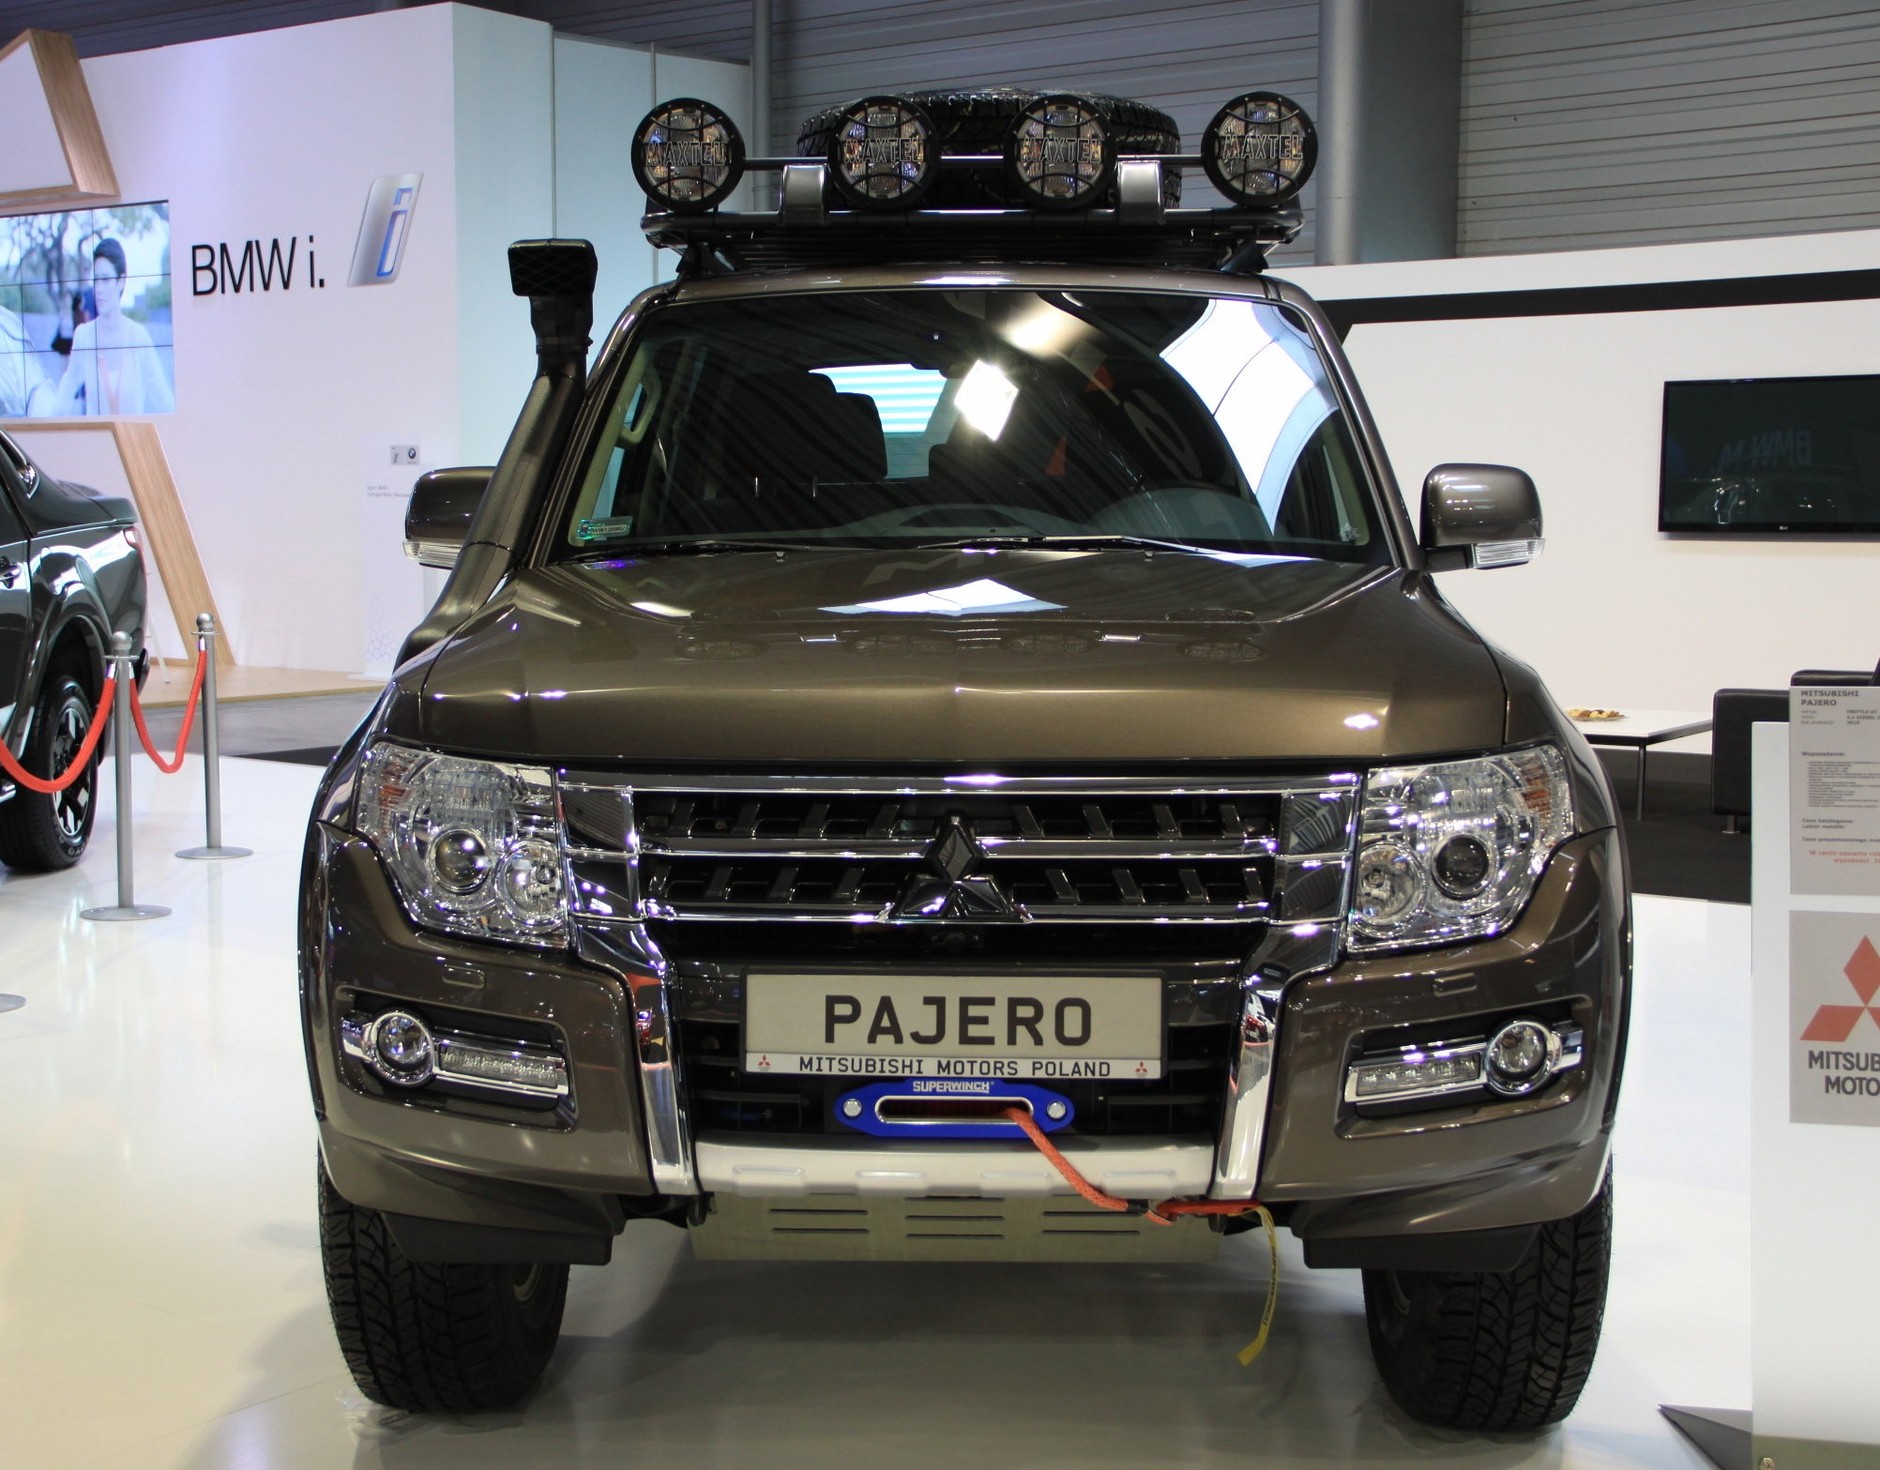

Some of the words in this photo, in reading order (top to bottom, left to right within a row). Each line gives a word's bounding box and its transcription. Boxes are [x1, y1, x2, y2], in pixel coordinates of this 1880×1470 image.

[1221, 133, 1304, 161] MAXTEL
[191, 236, 297, 296] BMW
[825, 994, 1092, 1047] PAJERO
[799, 1056, 924, 1075] MITSUBISHI
[936, 1059, 1019, 1076] MOTORS
[1031, 1060, 1111, 1077] POLAND
[1808, 1049, 1880, 1072] MITSUB
[1824, 1075, 1880, 1096] MOTO
